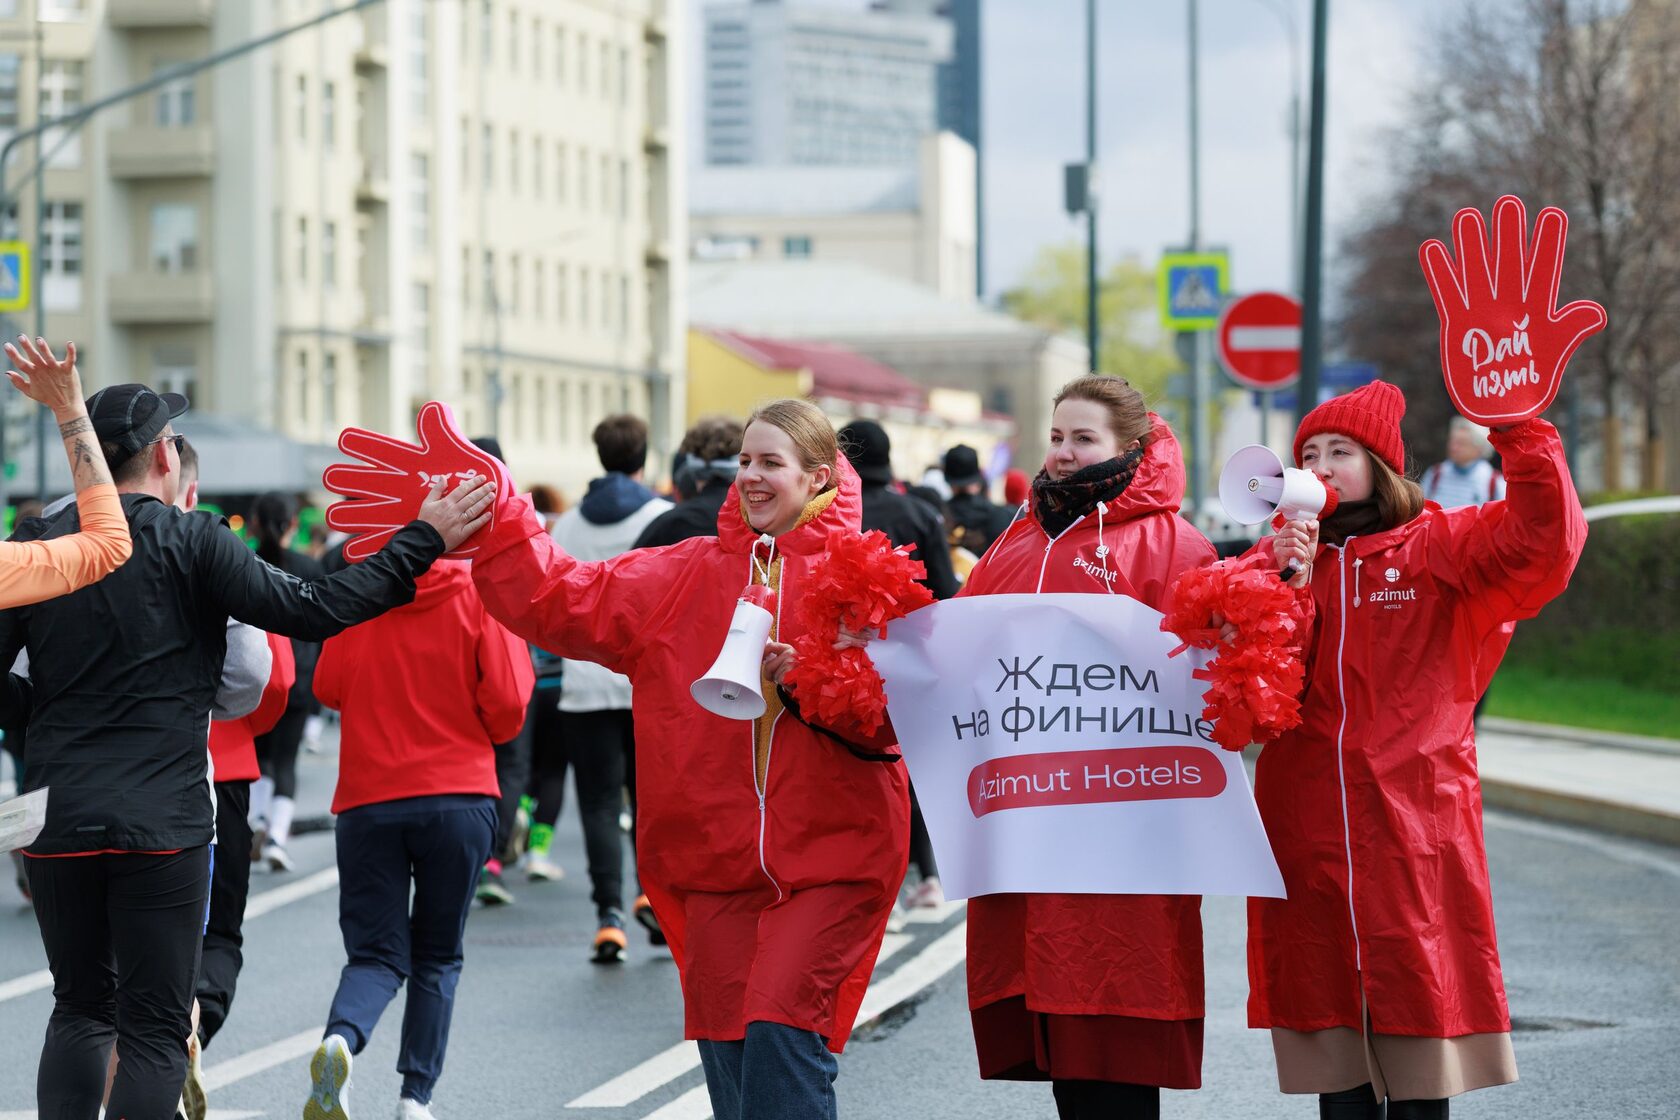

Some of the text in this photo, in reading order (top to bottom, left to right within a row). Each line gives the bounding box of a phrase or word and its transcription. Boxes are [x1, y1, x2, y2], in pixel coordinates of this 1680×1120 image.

[1462, 313, 1532, 371] Дай
[1473, 360, 1540, 398] пять
[1073, 557, 1117, 582] azimut
[1370, 588, 1416, 602] azimut
[995, 656, 1159, 696] Ждем
[952, 697, 1216, 743] на финише
[978, 760, 1202, 803] Azimut Hotels
